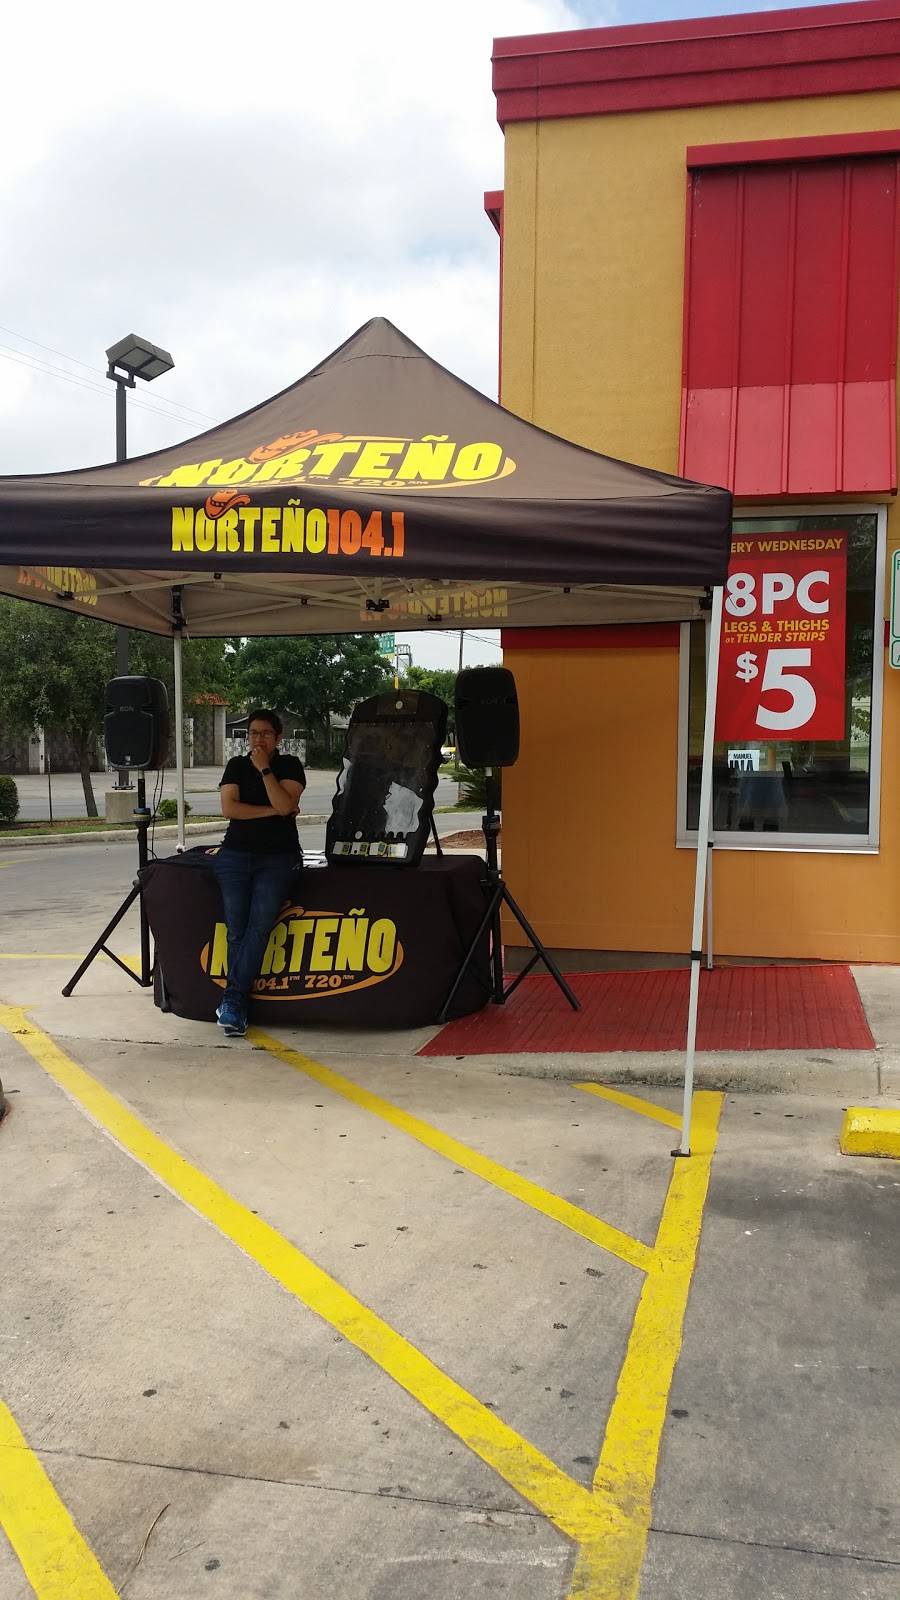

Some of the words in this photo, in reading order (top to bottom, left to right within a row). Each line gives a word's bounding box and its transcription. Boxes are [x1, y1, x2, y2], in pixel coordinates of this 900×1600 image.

[157, 434, 503, 488] NORTEÑO
[730, 541, 754, 553] ERY
[758, 538, 844, 552] WEDNESDAY
[724, 621, 757, 633] LEGS
[761, 621, 773, 632] &
[777, 619, 830, 632] THIGHS
[737, 632, 782, 644] TENDER
[785, 631, 826, 643] STRIPS
[210, 907, 397, 976] NRTEÑO
[304, 974, 342, 988] 720
